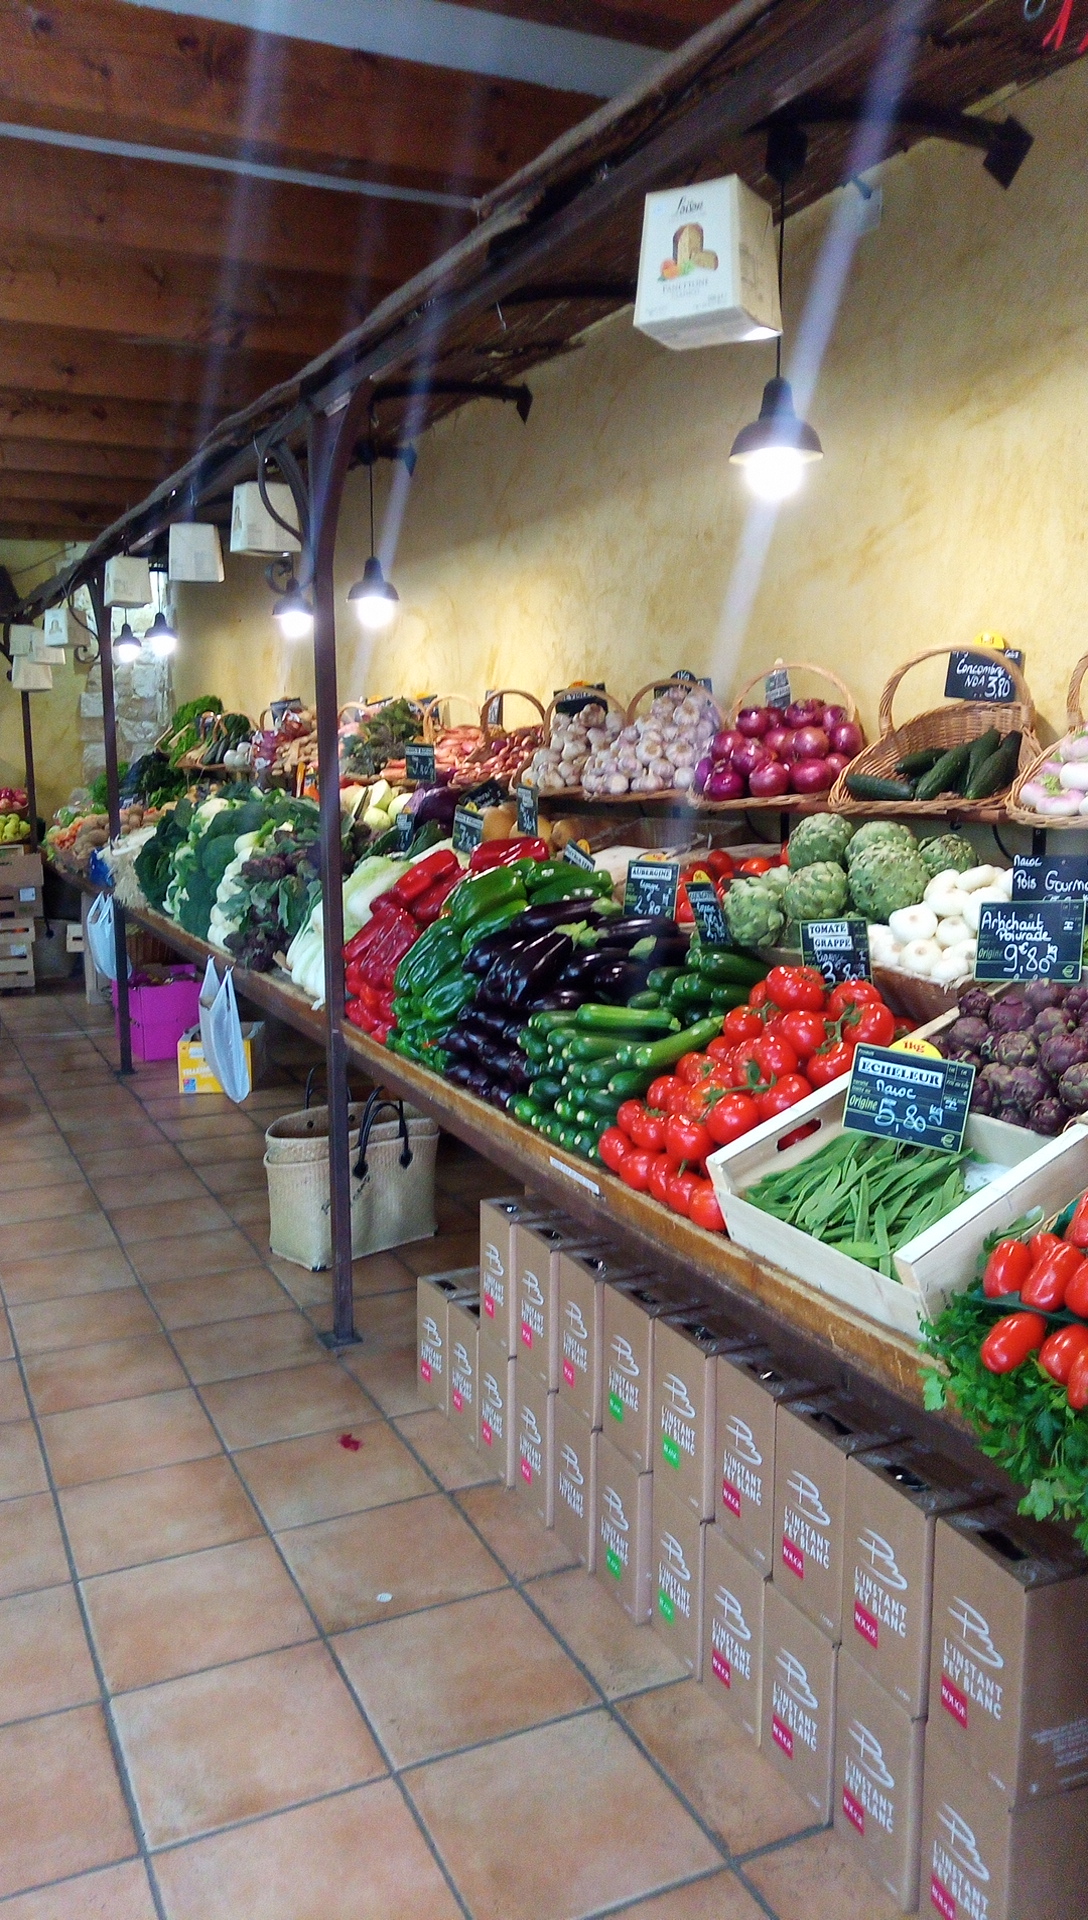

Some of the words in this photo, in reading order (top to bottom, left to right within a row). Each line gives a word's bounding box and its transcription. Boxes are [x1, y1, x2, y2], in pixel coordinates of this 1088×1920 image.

[810, 924, 847, 934] TOMATE
[814, 939, 851, 948] GRAPPE
[861, 1061, 940, 1086] ECHELEUR
[849, 1094, 879, 1111] Origine
[724, 1449, 762, 1490] L'INSTANT
[736, 1476, 762, 1507] BLANC
[785, 1505, 830, 1552] L'INSTANT
[799, 1536, 830, 1570] BLANC
[854, 1566, 907, 1620] L'INSTANT
[854, 1581, 870, 1605] PEY
[872, 1599, 907, 1638] BLANC
[712, 1618, 751, 1665] L'INSTANT
[725, 1646, 751, 1680] BLANC
[944, 1637, 1003, 1701] L'INSTANT
[773, 1680, 818, 1735] L'INSTANT
[943, 1654, 960, 1682] PEY
[963, 1676, 1002, 1720] BLANC
[788, 1714, 817, 1752] BLANC
[845, 1755, 894, 1817] L'INSTANT
[861, 1793, 893, 1834] BLANC
[933, 1840, 989, 1912] L'INSTANT
